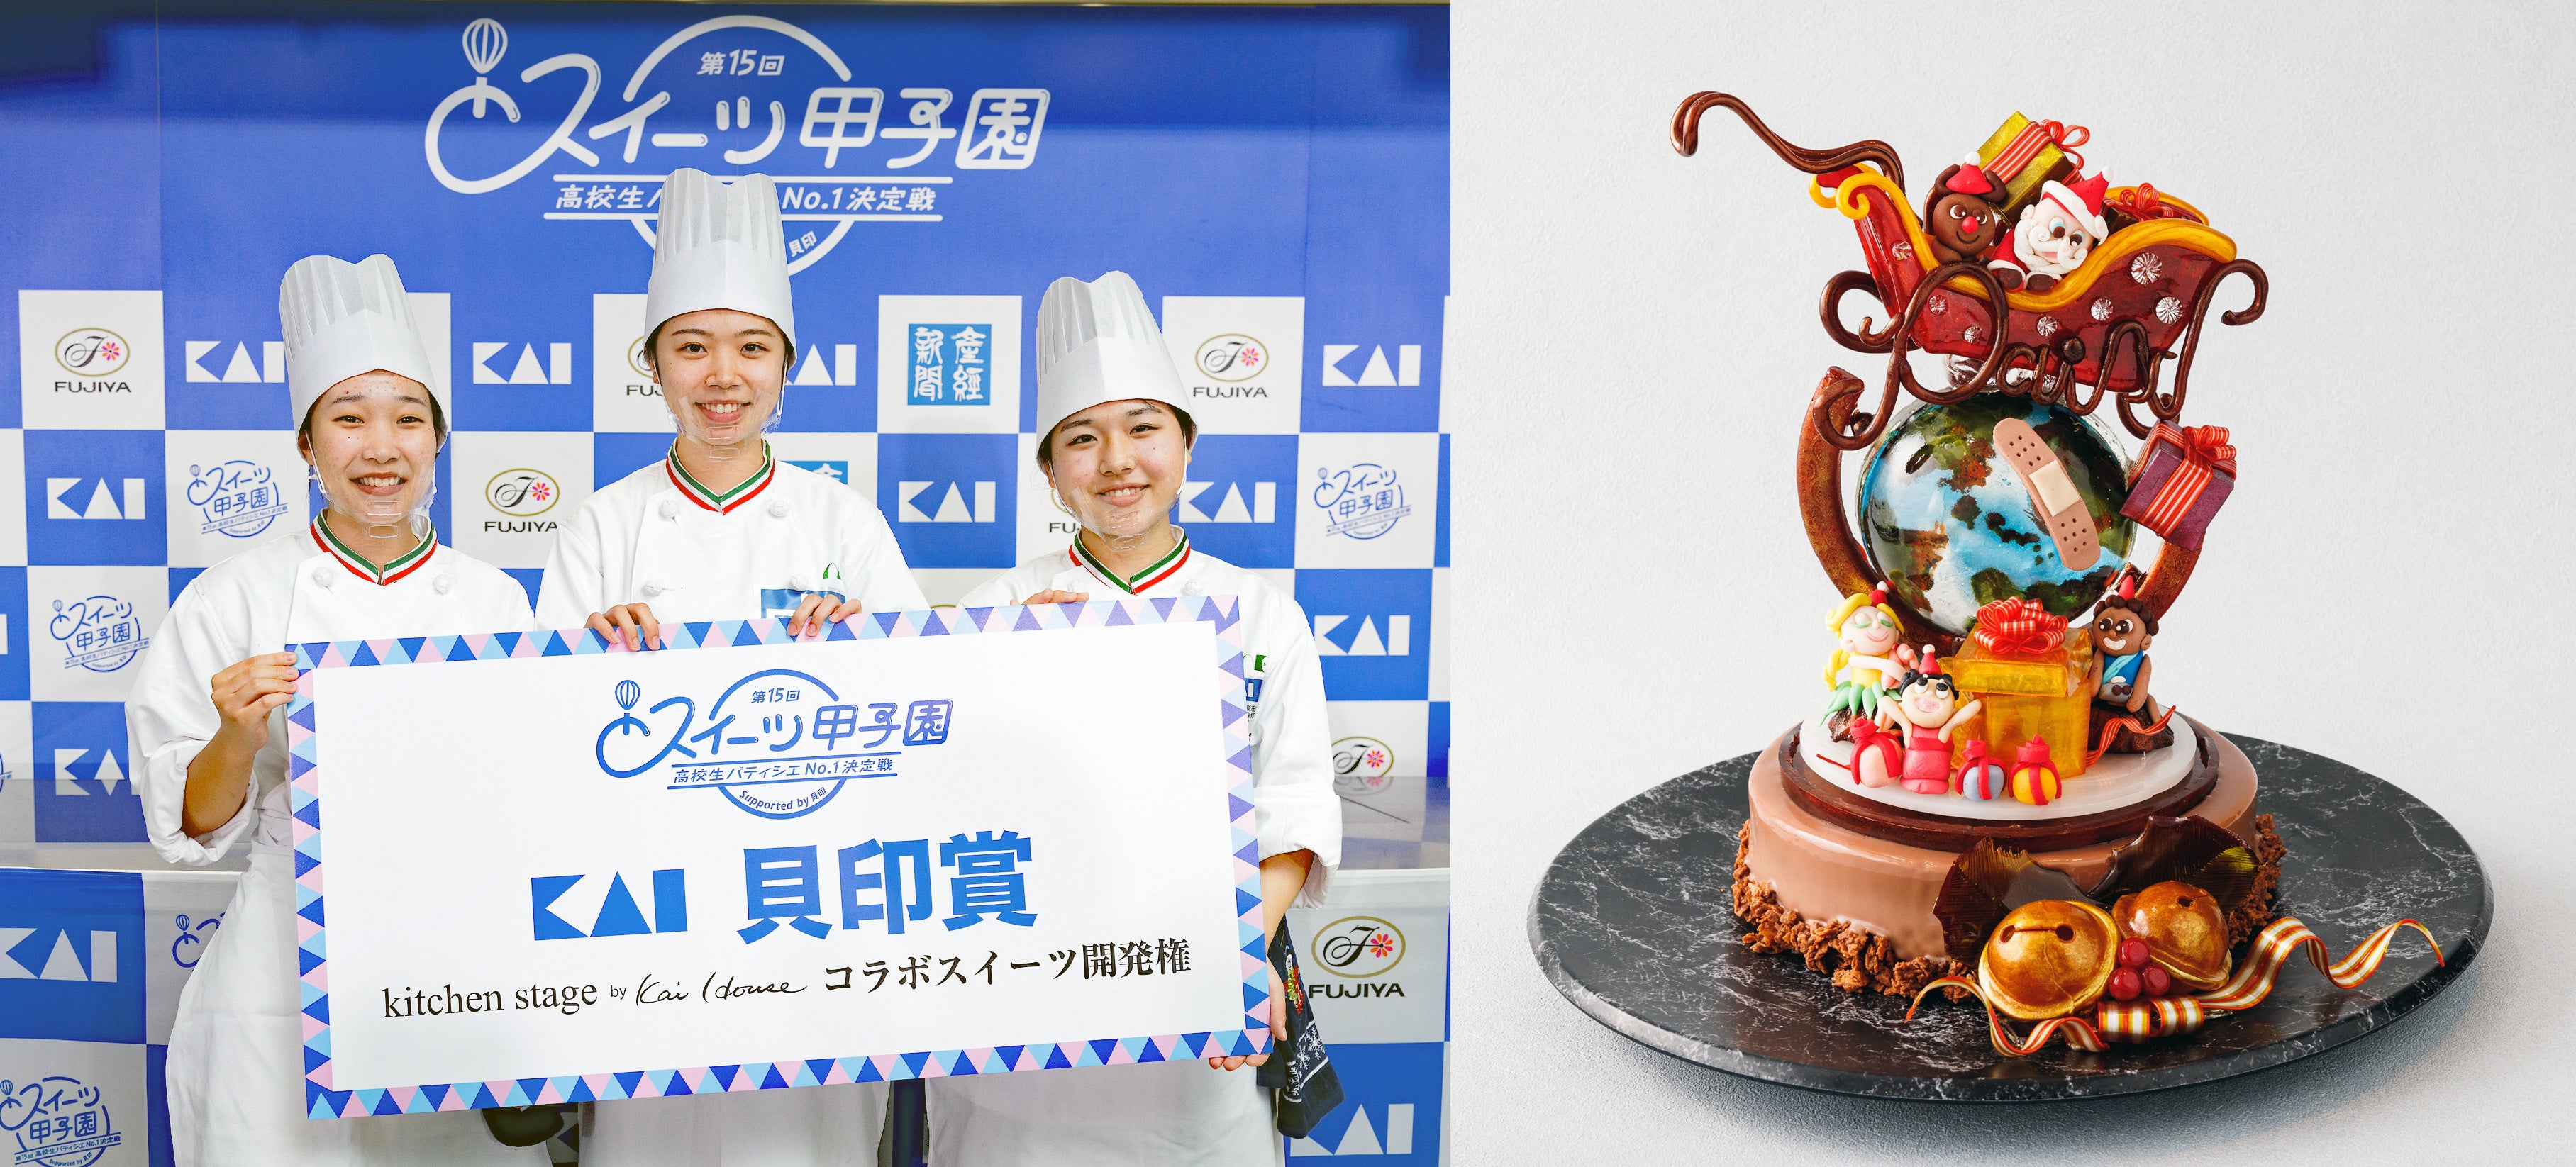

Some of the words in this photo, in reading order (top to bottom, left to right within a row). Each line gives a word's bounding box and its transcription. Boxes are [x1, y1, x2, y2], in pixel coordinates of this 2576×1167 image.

[698, 50, 784, 76] 第15回
[425, 53, 1050, 195] スイーツ甲子園
[788, 230, 818, 257] 貝印
[185, 340, 284, 383] KAI
[473, 342, 571, 384] KAI
[785, 344, 856, 386] AI
[1322, 344, 1422, 386] KAI
[54, 381, 131, 393] FUJIYA
[1193, 386, 1268, 398] FUJIYA
[47, 478, 145, 520] KAI
[187, 467, 271, 506] スイーツ
[214, 487, 269, 516] 甲子園
[899, 481, 996, 523] KAI
[1179, 481, 1276, 523] KAI
[1314, 470, 1397, 508] スイーツ
[1340, 490, 1393, 518] 甲子園
[484, 521, 557, 533] FUJIYA
[50, 603, 133, 640] スイーツ
[77, 622, 130, 650] 甲子園
[1314, 615, 1411, 656] KAI
[751, 687, 801, 704] 第15回
[596, 697, 953, 778] スイーツ甲子園
[740, 790, 794, 810] Supported
[796, 795, 809, 808] by
[810, 786, 826, 803] 貝印
[531, 869, 688, 941] KAI
[738, 830, 1038, 944] 貝印賞
[0, 927, 117, 983] KAI
[382, 983, 504, 1018] kitchen
[516, 982, 598, 1015] stage
[610, 985, 627, 1000] by
[636, 974, 689, 1007] Kai
[825, 938, 1192, 993] コラボスイーツ開発権
[1309, 983, 1405, 999] FUJIYA
[0, 1083, 100, 1131] スイーツ
[30, 1111, 97, 1144] 甲子園
